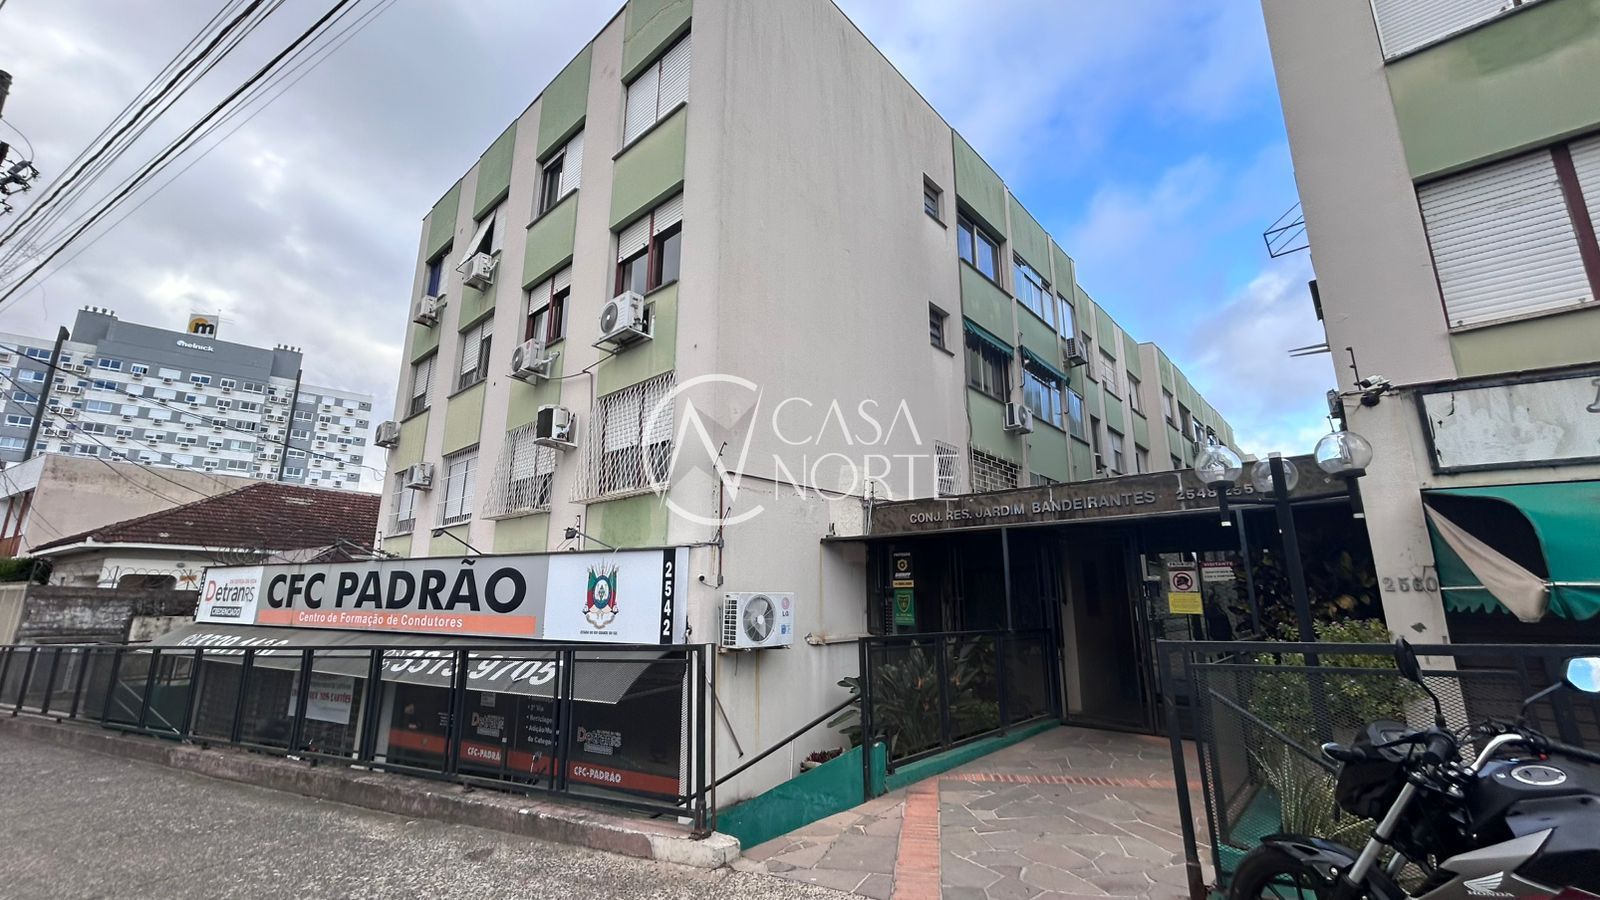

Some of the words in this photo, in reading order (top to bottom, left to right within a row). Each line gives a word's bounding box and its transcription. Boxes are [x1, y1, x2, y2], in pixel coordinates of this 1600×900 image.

[909, 512, 943, 524] CONJ.
[946, 508, 973, 521] RES.
[975, 502, 1025, 519] JARDIM
[1032, 490, 1156, 514] BANDEIRANTES
[1175, 488, 1217, 500] 2548
[267, 572, 326, 609] CFC
[335, 558, 527, 614] PADRÃO
[663, 561, 673, 636] 2542
[299, 611, 325, 623] Centro
[327, 612, 338, 623] de
[340, 611, 384, 627] Formação
[387, 614, 398, 625] de
[400, 614, 464, 628] Condutores
[1466, 889, 1515, 898] HONDA
